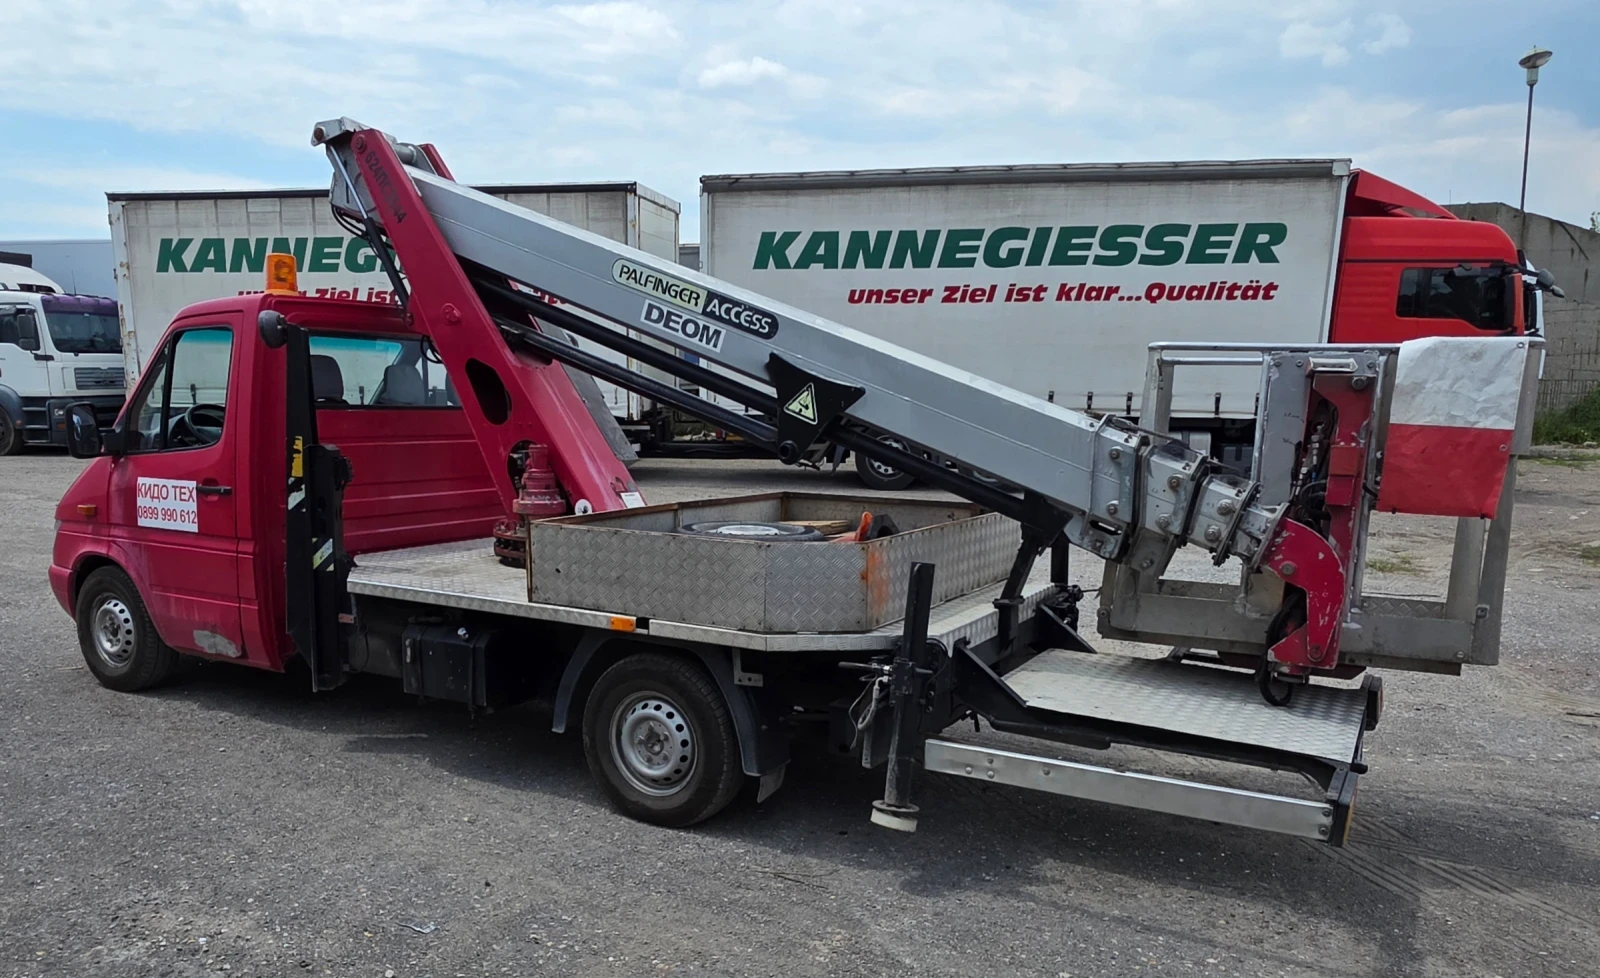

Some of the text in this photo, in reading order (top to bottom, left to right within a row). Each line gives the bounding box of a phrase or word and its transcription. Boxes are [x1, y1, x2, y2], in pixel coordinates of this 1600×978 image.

[752, 222, 1287, 270] KANNEGIESSER
[619, 264, 772, 334] PALFINGER ACCESS
[848, 288, 934, 304] unser
[941, 284, 998, 304] Ziel
[1004, 283, 1048, 303] ist
[643, 303, 722, 349] DEOM
[137, 483, 195, 503] КИДО ТЕХ
[137, 505, 197, 525] 0899 990 612
